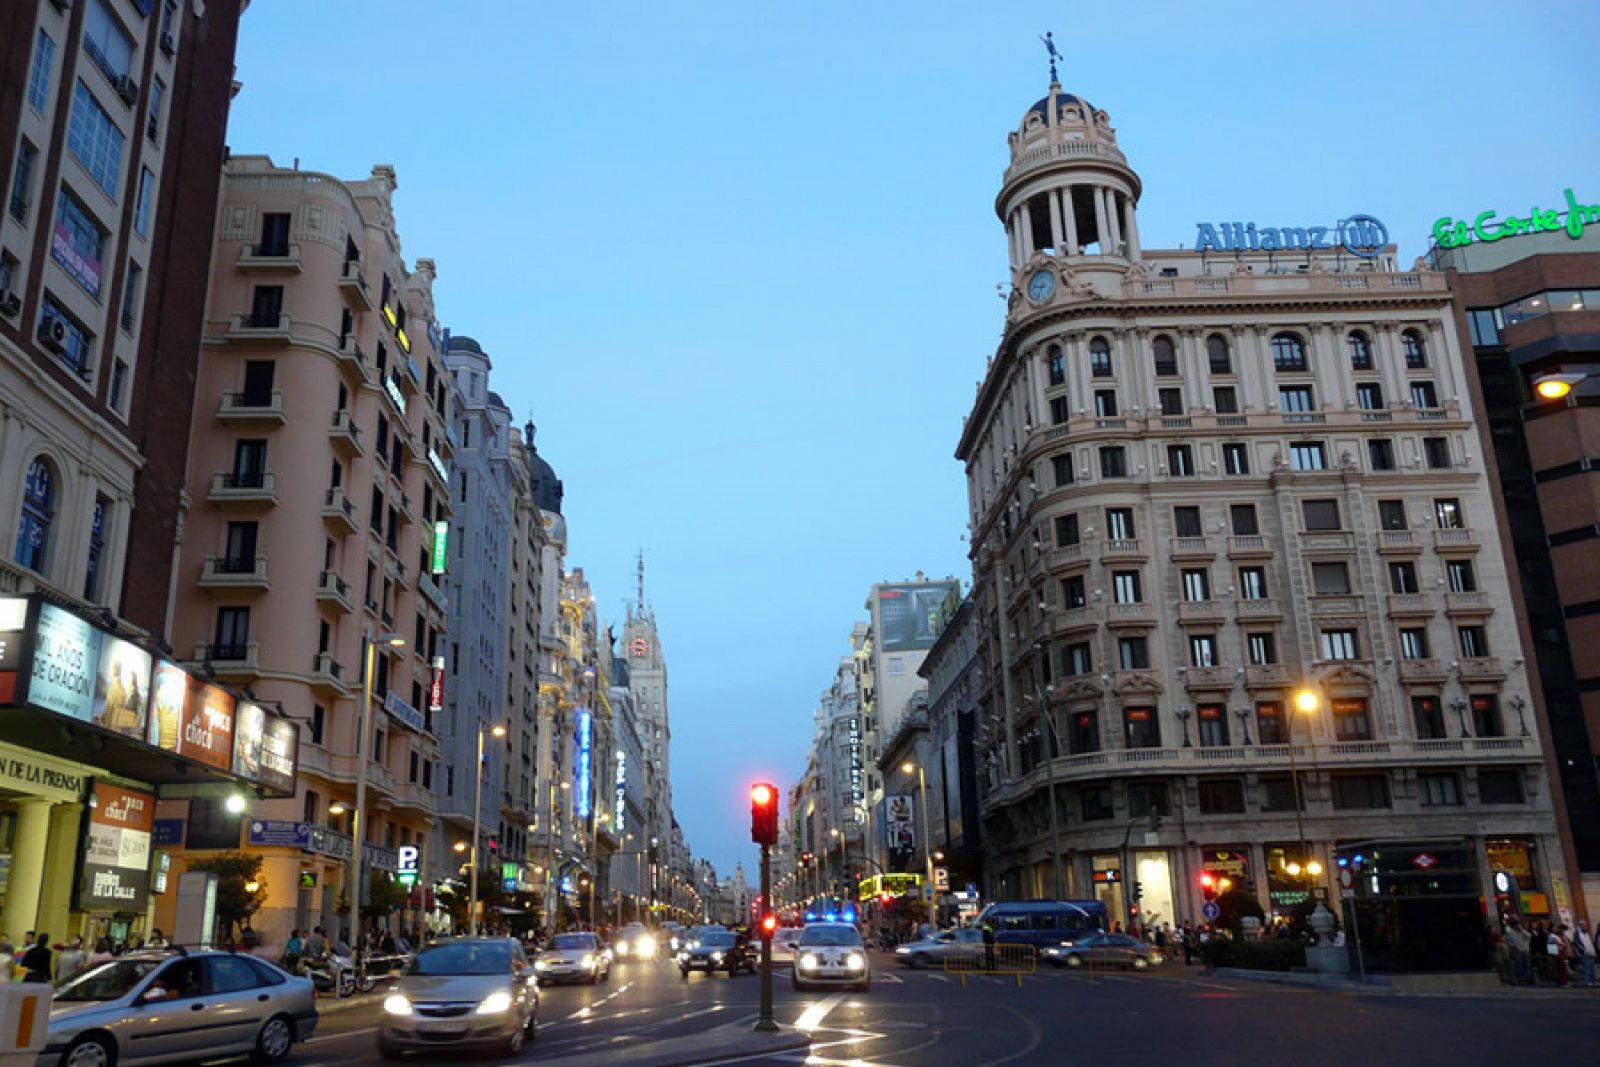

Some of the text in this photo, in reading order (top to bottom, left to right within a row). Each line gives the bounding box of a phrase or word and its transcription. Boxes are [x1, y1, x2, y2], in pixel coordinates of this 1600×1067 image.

[1195, 221, 1331, 251] Allianz
[1432, 217, 1468, 249] El
[1474, 208, 1561, 242] Corte
[9, 760, 25, 779] DE
[27, 764, 40, 783] LA
[43, 768, 81, 793] PRENSA
